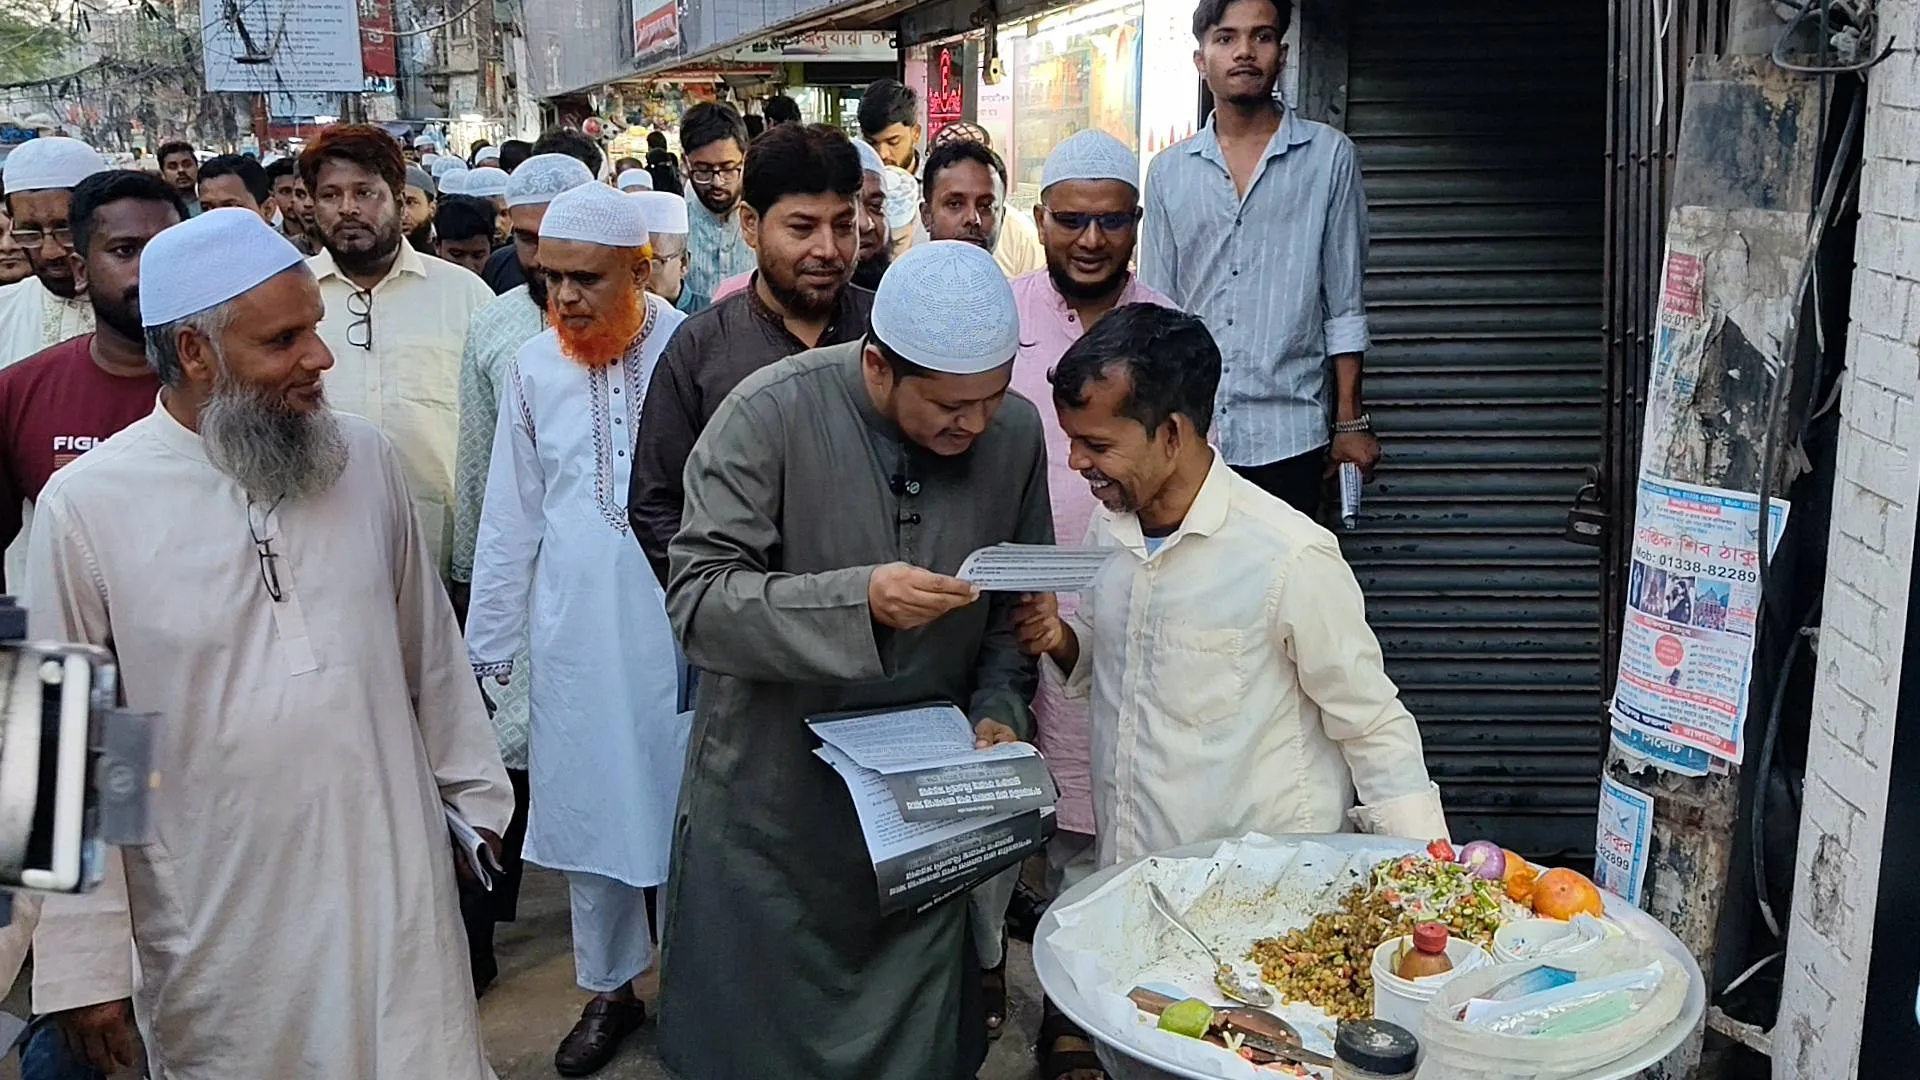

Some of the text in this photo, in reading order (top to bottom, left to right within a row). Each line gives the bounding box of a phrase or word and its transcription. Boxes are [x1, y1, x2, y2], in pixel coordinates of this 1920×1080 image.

[1680, 534, 1712, 557] শিব
[1719, 540, 1760, 569] ঠাকু
[1659, 555, 1757, 583] 01338-82289
